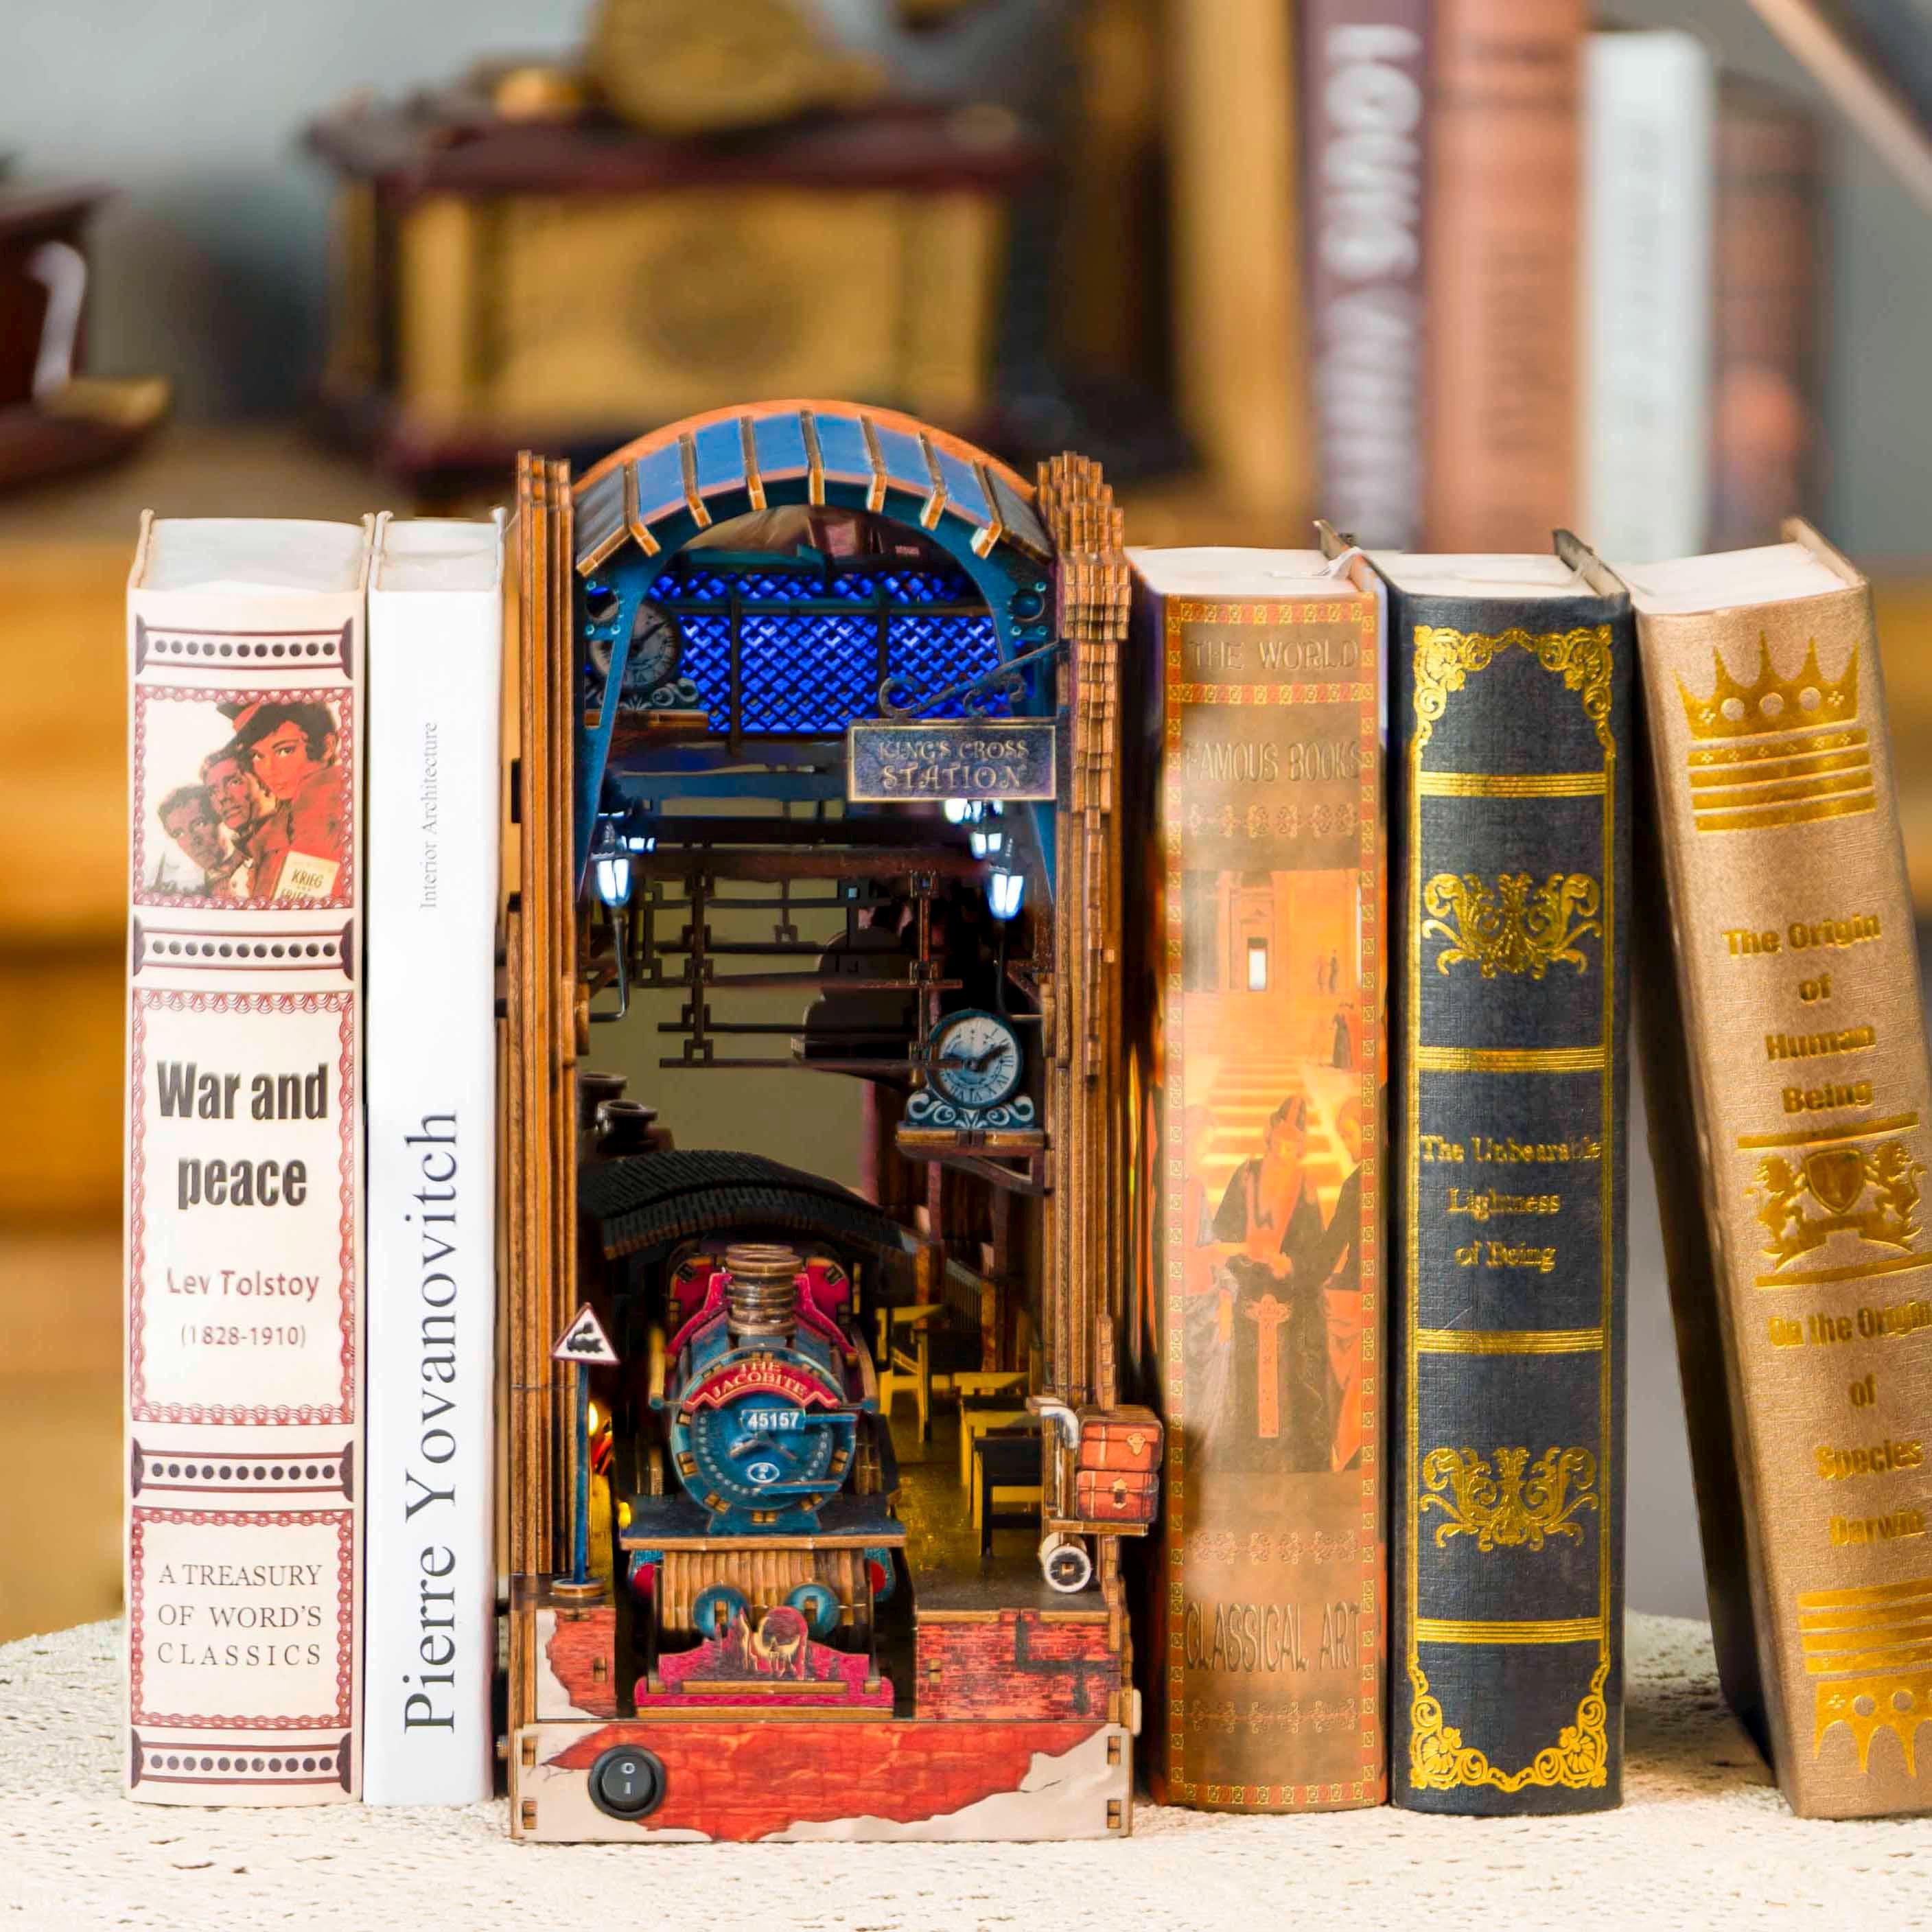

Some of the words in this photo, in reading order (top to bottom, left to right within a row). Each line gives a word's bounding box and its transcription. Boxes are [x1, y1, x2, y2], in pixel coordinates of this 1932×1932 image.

[1189, 640, 1246, 671] THE
[1258, 640, 1359, 671] WORLD
[958, 740, 1029, 759] CROSS
[1185, 741, 1279, 782] FAMOUS
[1289, 739, 1362, 781] BOOKS
[419, 722, 438, 835] Architecture
[881, 762, 1027, 790] STATION
[291, 868, 324, 889] KRIEG
[419, 841, 438, 909] Interior
[1721, 929, 1782, 957] The
[1786, 913, 1883, 948] Origin
[1799, 974, 1832, 1003] of
[1764, 1025, 1877, 1061] Human
[156, 1060, 241, 1120] War
[250, 1062, 329, 1121] and
[1782, 1080, 1874, 1113] Being
[1419, 1134, 1465, 1163] The
[177, 1157, 307, 1210] peace
[1454, 1241, 1480, 1266] of
[167, 1268, 210, 1296] Lev
[220, 1270, 320, 1302] Tolstoy
[404, 1110, 458, 1523] Yovanovitch
[1807, 1311, 1853, 1347] the
[181, 1325, 307, 1349] (1828-1910)
[741, 1361, 782, 1373] THE
[712, 1371, 808, 1397] JACOBITE
[1849, 1372, 1877, 1407] of
[747, 1412, 800, 1429] 45157
[159, 1563, 176, 1585] A
[181, 1563, 323, 1587] TREASURY
[157, 1604, 195, 1627] OF
[209, 1605, 322, 1629] WORD'S
[402, 1545, 455, 1734] Pierre
[1185, 1602, 1310, 1673] CLASSICAL
[1319, 1601, 1362, 1671] ART
[156, 1642, 321, 1666] CLASSICS
